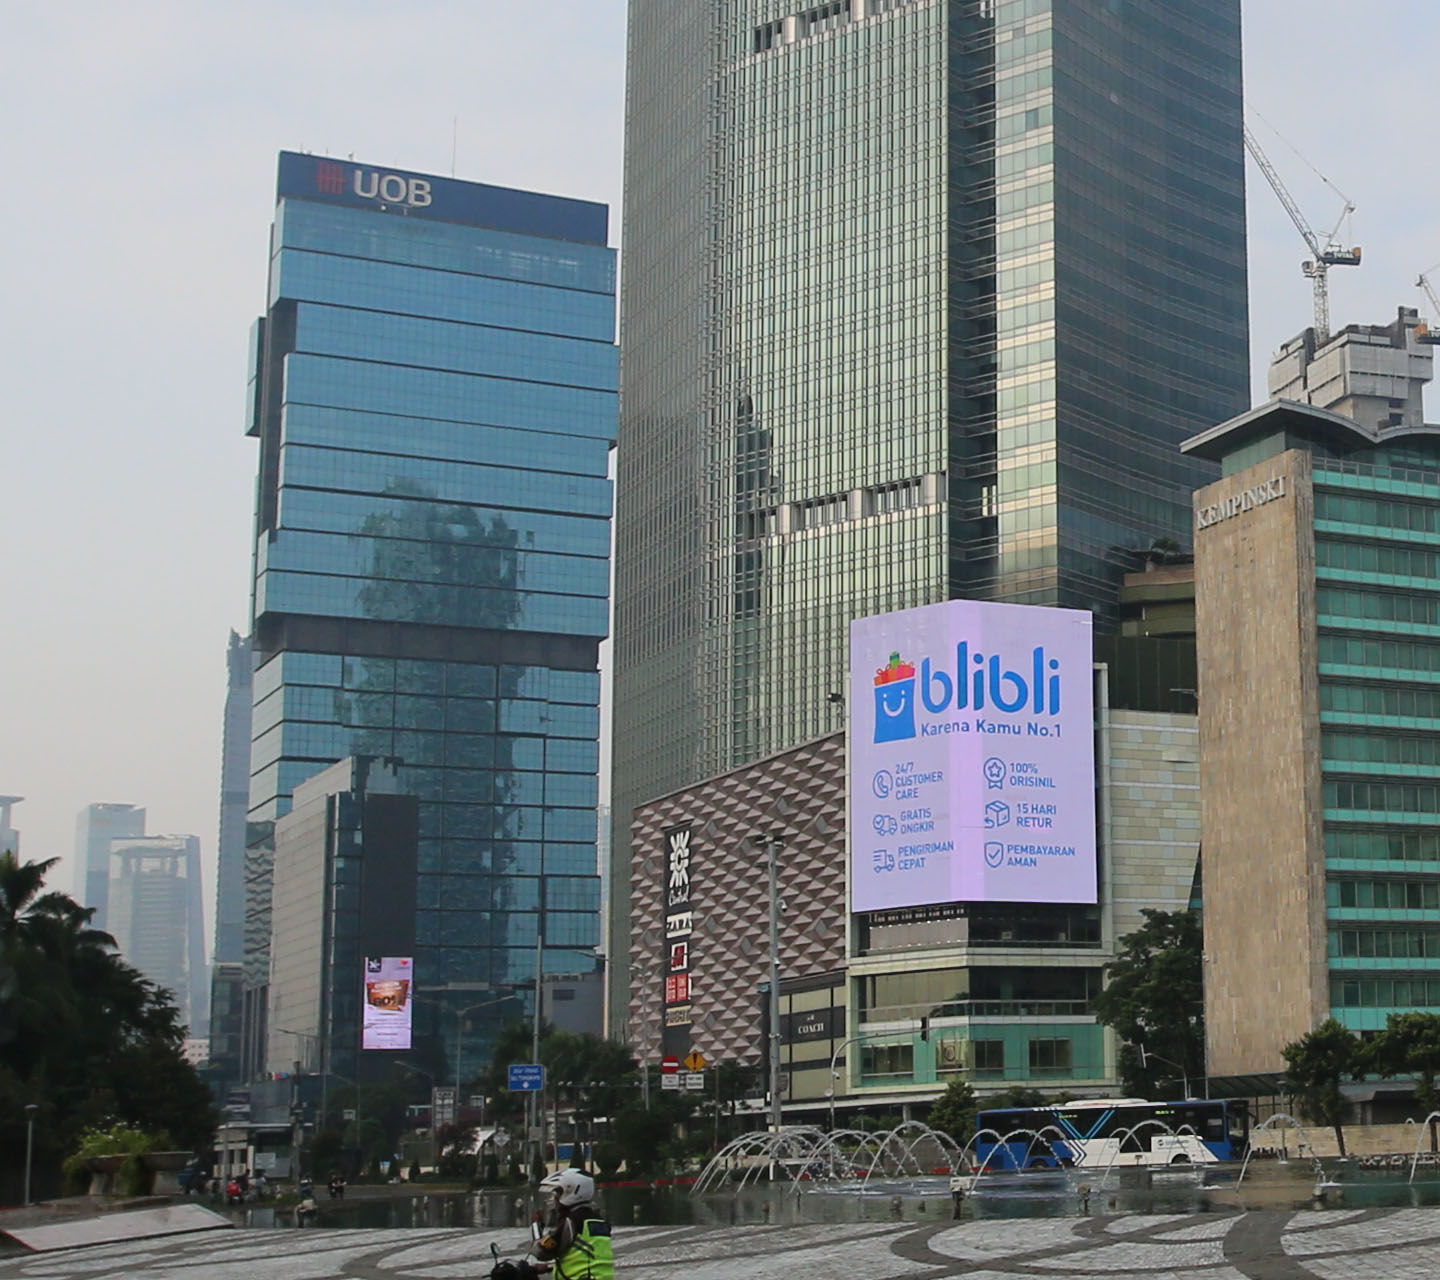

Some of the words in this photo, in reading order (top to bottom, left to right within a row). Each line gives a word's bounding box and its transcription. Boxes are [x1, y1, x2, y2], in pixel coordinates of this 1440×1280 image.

[353, 168, 433, 207] UOB
[1196, 475, 1287, 530] KEMPINSKI
[921, 640, 1060, 716] blibli
[921, 720, 970, 737] Karena
[975, 719, 1021, 735] Kamu
[1027, 723, 1061, 738] No.1
[895, 762, 914, 775] 24/7
[1010, 762, 1038, 775] 100%
[895, 771, 943, 788] CUSTOMER
[1010, 776, 1056, 789] ORISINIL
[895, 787, 919, 800] CARE
[900, 808, 931, 821] GRATIS
[1016, 803, 1028, 815] 15
[1031, 804, 1057, 816] HARI
[900, 821, 935, 834] ONGKIR
[1016, 817, 1053, 829] RETUR
[898, 840, 954, 857] PENGIRIMAN
[1007, 844, 1076, 857] PEMBAYARAN
[898, 857, 926, 870] CEPAT
[1007, 856, 1038, 868] AMAN
